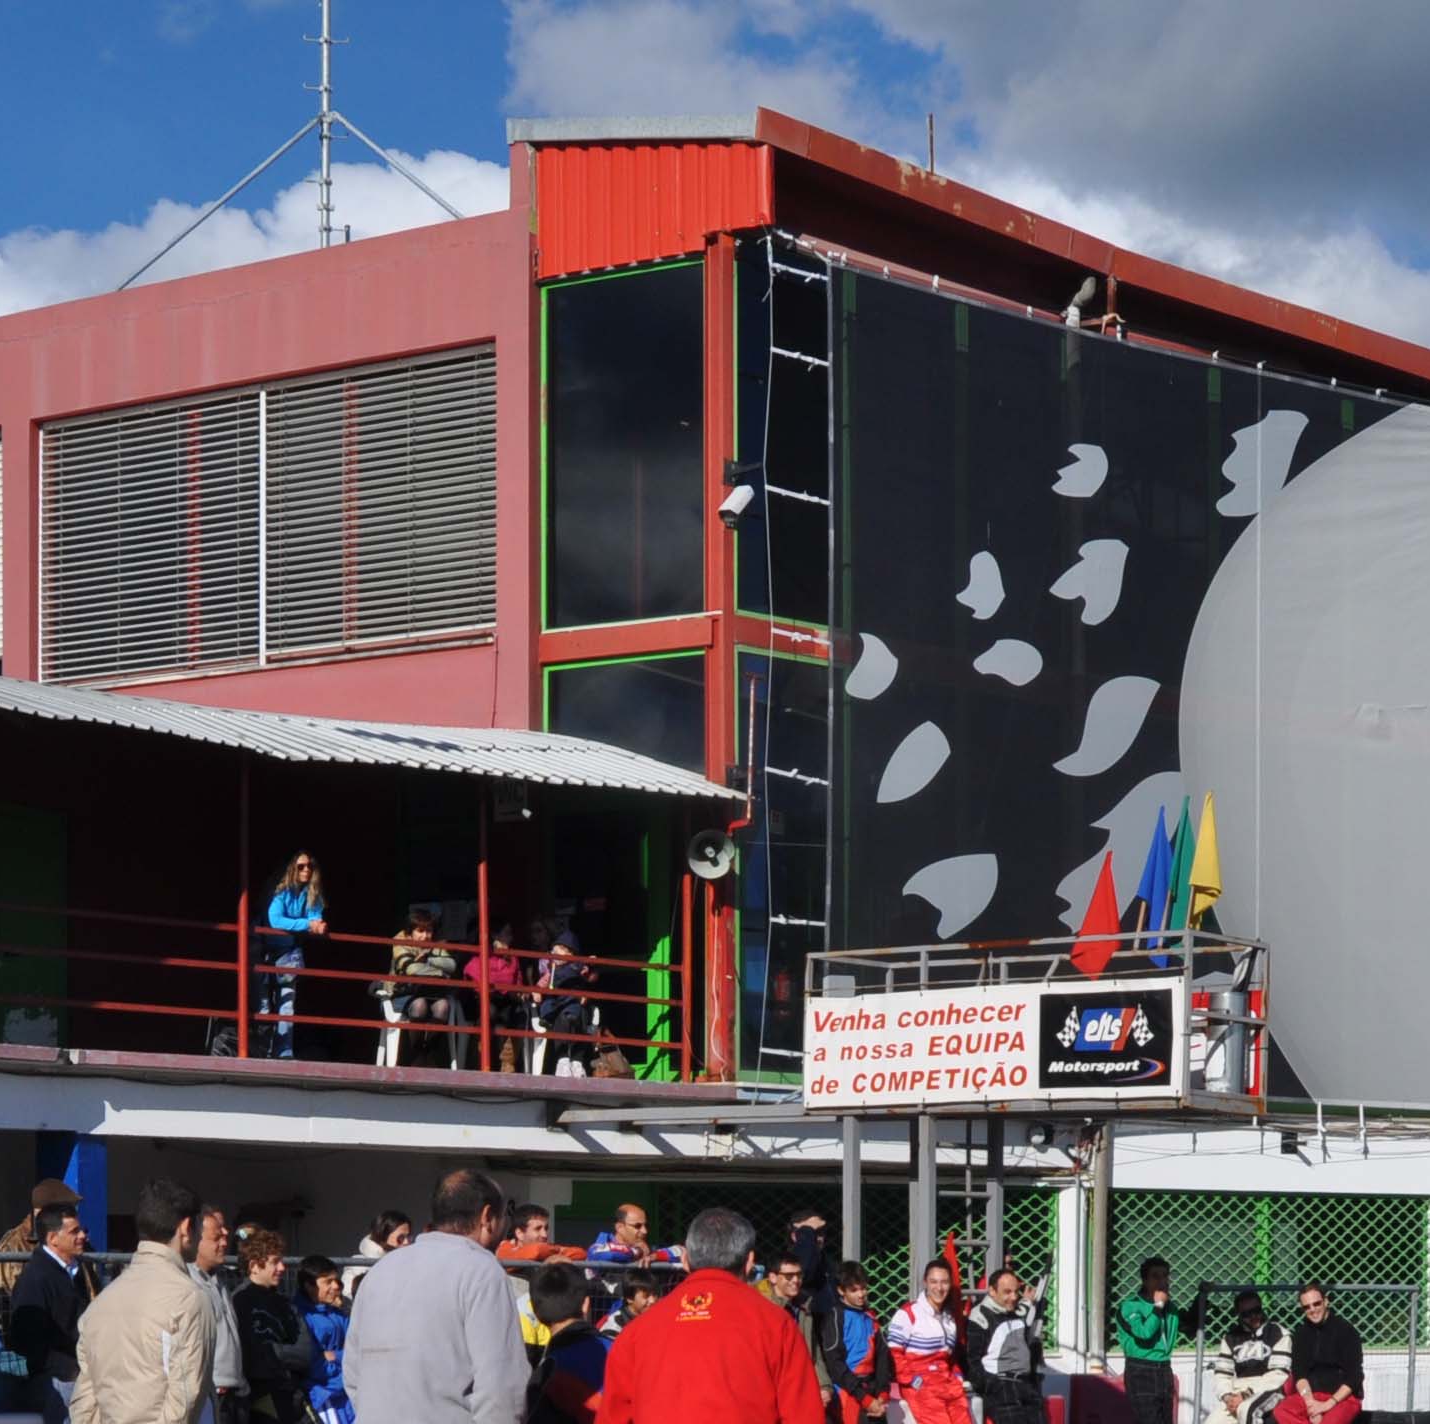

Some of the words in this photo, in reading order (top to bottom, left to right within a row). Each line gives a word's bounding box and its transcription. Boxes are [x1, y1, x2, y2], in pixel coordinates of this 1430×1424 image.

[813, 1008, 886, 1032] Venha
[897, 1003, 1026, 1028] conhecer
[813, 1047, 827, 1062] a
[840, 1042, 914, 1060] nossa
[928, 1031, 1026, 1056] EQUIPA
[810, 1075, 839, 1094] de
[852, 1061, 1028, 1094] COMPETIÇÃO
[1048, 1059, 1140, 1074] Motorsport
